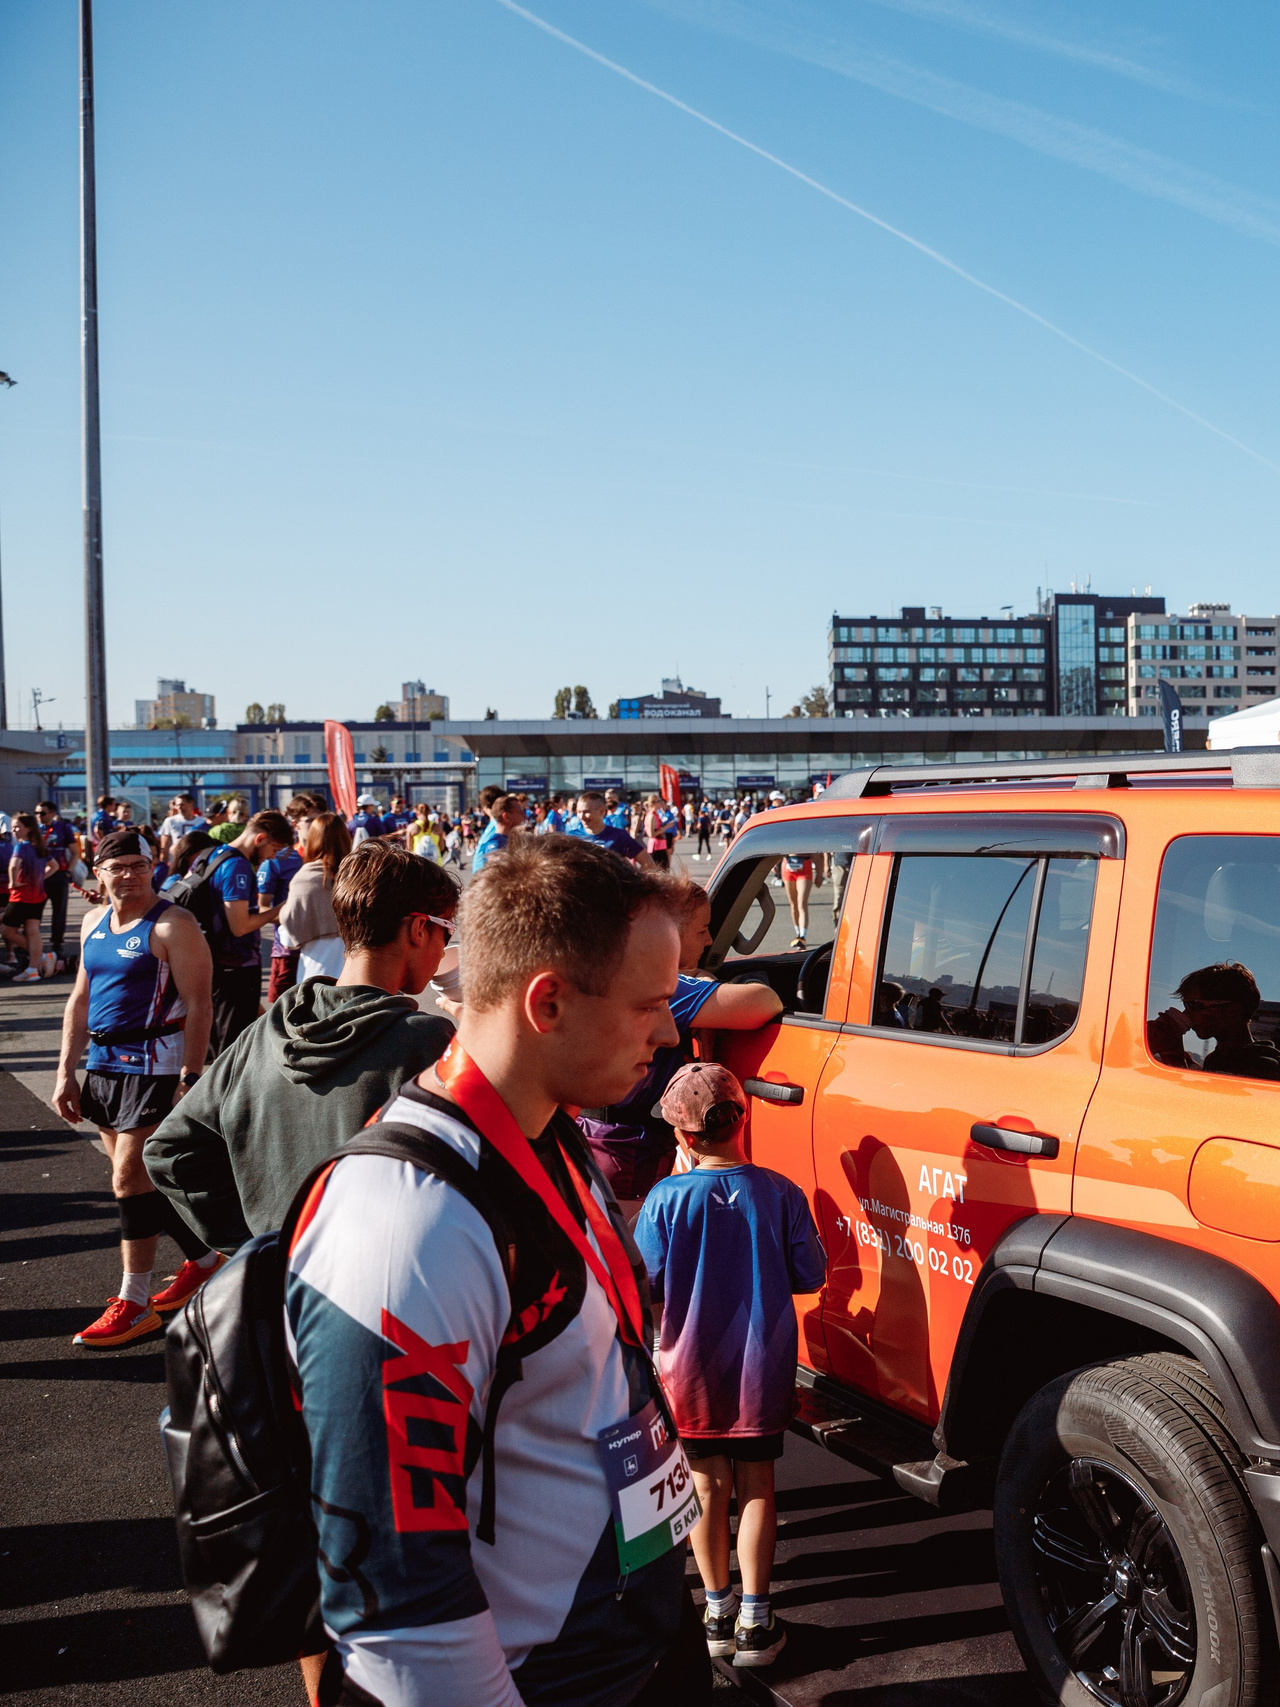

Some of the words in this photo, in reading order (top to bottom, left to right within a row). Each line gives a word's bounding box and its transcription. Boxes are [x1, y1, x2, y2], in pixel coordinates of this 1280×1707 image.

[918, 1164, 968, 1204] АГАТ
[858, 1196, 945, 1236] ул.Магистральная
[836, 1215, 851, 1237] +7
[856, 1220, 891, 1258] (831)
[894, 1234, 924, 1266] 200
[928, 1247, 950, 1276] 02
[952, 1256, 974, 1285] 02
[381, 1307, 475, 1533] FOX
[673, 1518, 684, 1537] 5
